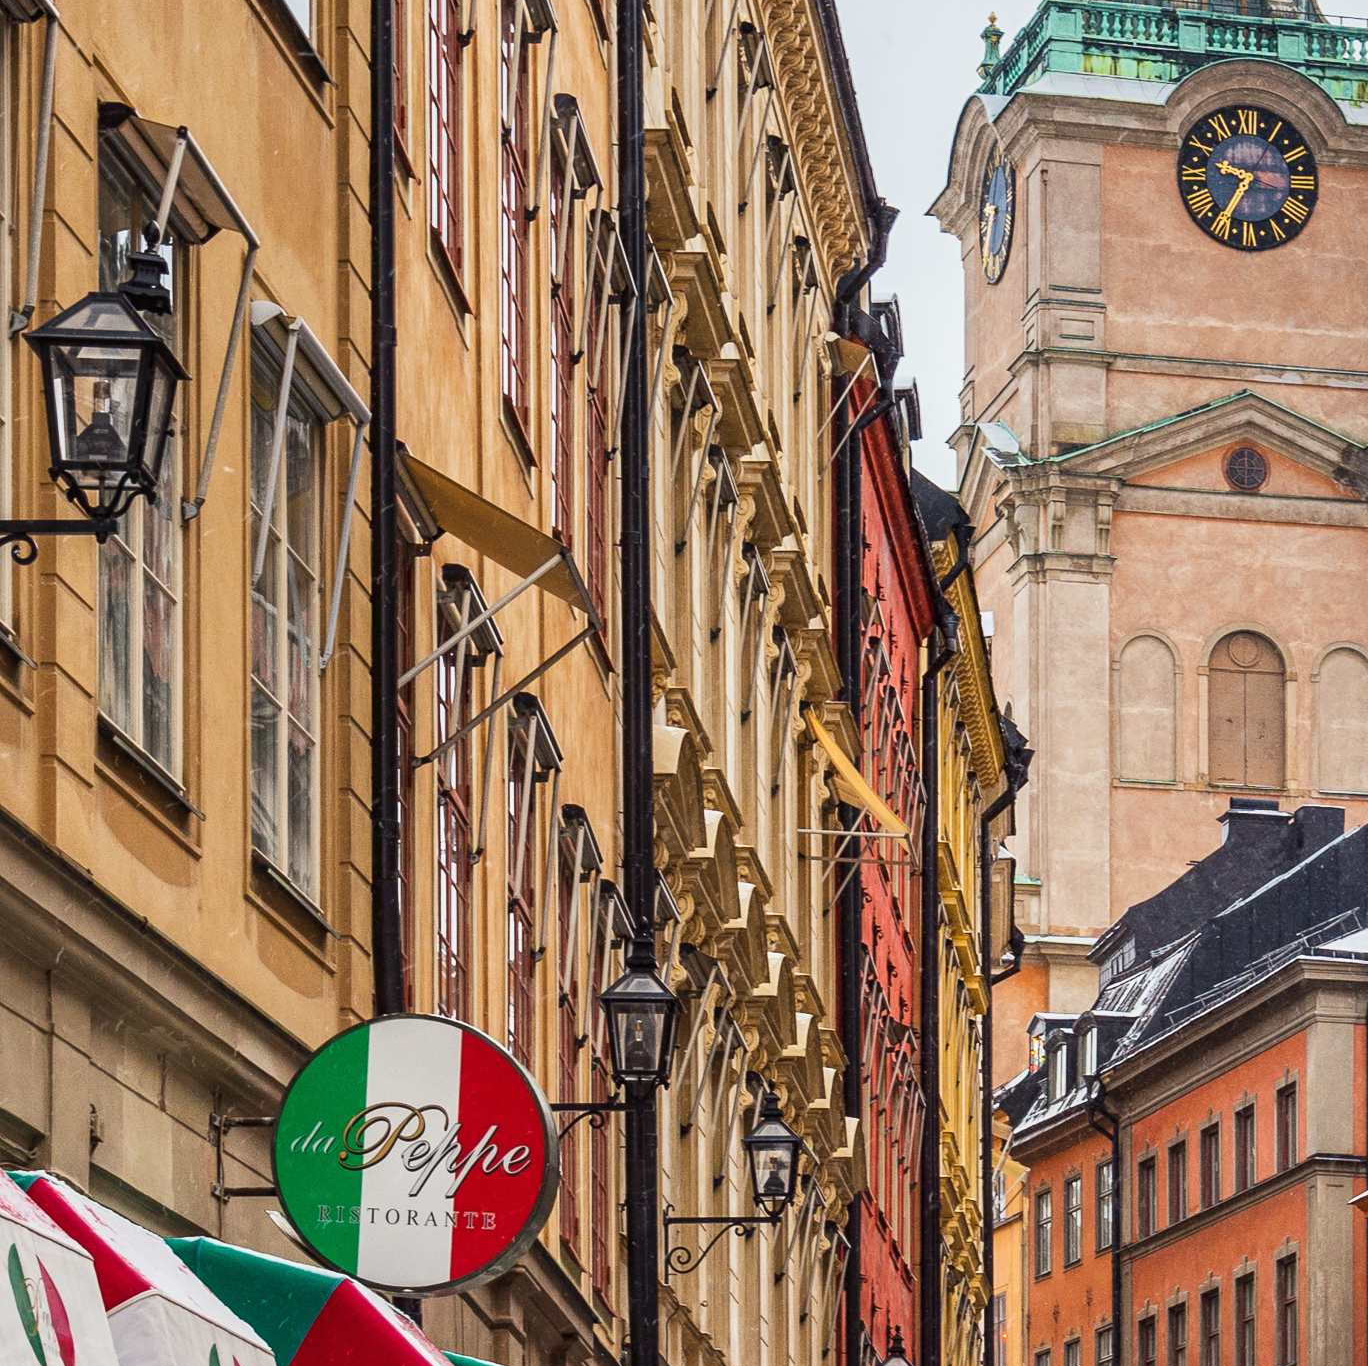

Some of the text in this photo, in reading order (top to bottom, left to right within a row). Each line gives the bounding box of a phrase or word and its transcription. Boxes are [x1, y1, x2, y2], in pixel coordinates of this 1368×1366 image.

[1208, 114, 1232, 141] XI
[1238, 110, 1257, 135] XII
[1268, 122, 1282, 141] I
[1189, 135, 1214, 156] X
[1283, 146, 1307, 163] II
[1182, 165, 1206, 180] IX
[1290, 175, 1314, 189] III
[1187, 189, 1214, 218] VIII
[1281, 197, 1308, 224] IIII
[1243, 222, 1257, 246] VI
[1270, 219, 1286, 241] V
[291, 1101, 531, 1199] da Peppe
[318, 1205, 497, 1229] RISTORANTE
